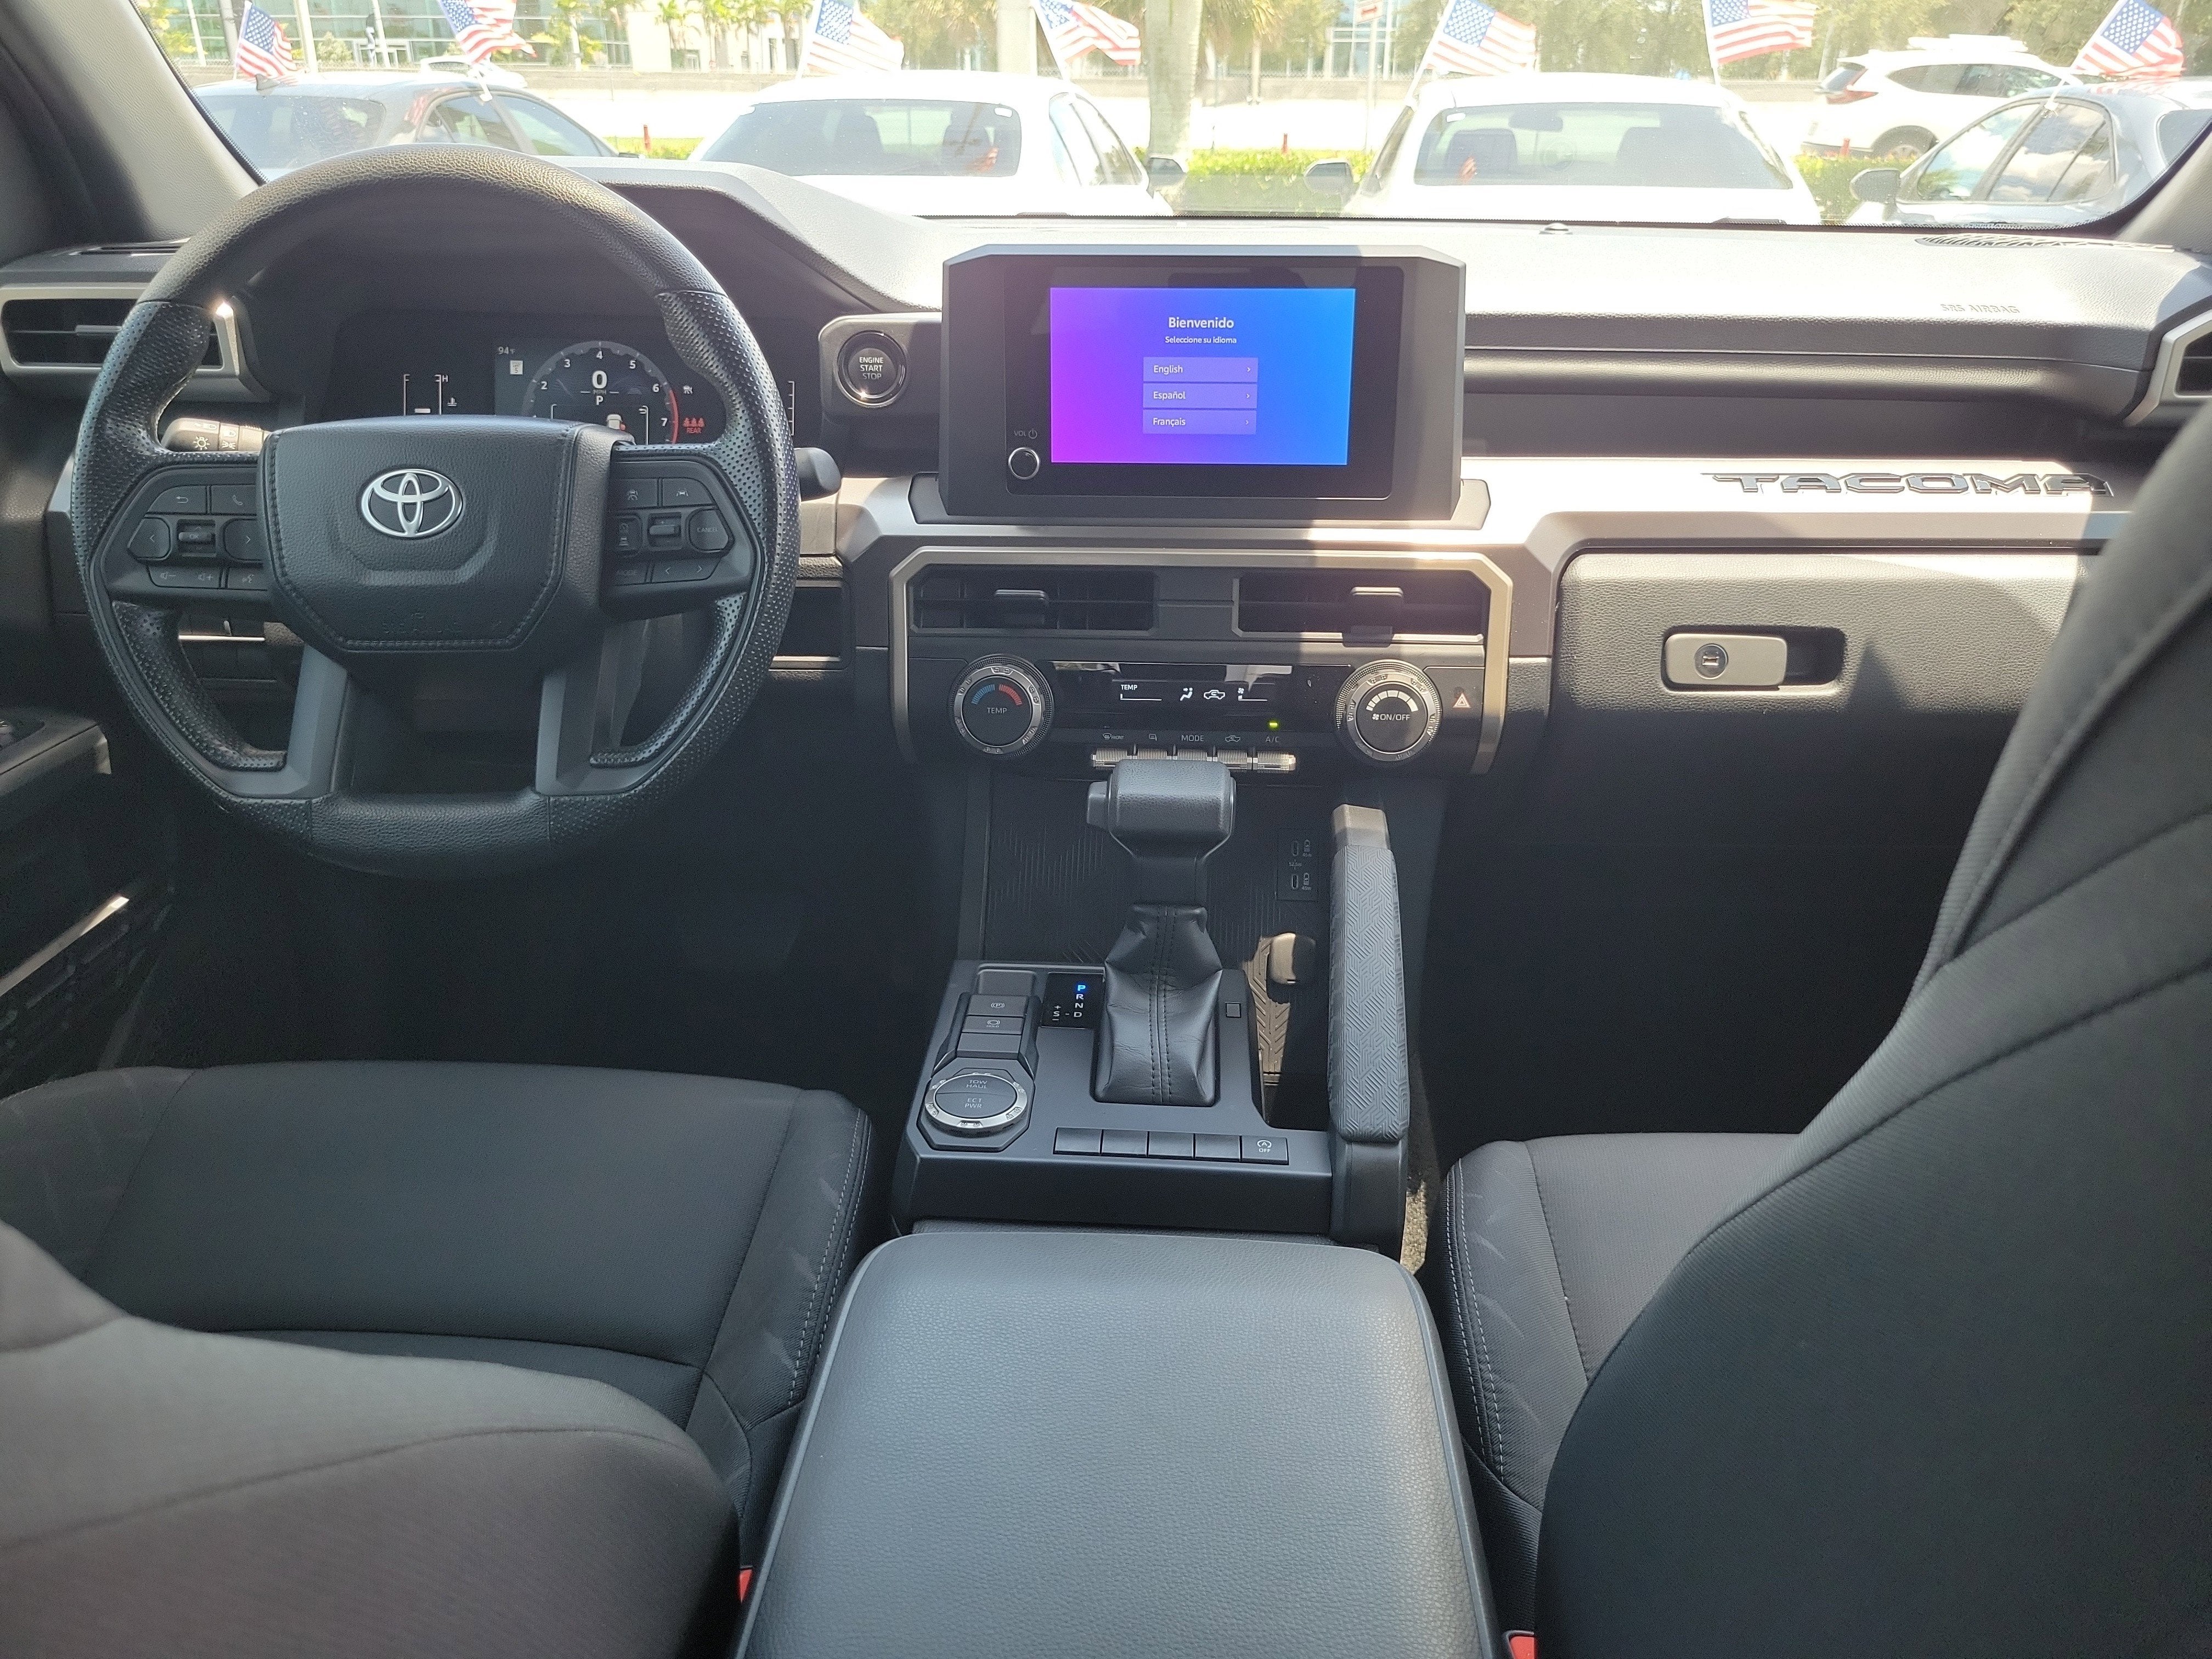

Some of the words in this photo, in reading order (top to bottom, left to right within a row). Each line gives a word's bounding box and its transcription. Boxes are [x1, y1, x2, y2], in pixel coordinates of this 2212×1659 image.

[1168, 317, 1234, 328] Bienvenido
[1165, 336, 1202, 344] Seleccione
[1212, 336, 1237, 344] idioma
[596, 351, 603, 360] 4
[564, 359, 571, 368] 3
[629, 360, 636, 369] 5
[1153, 365, 1183, 375] English
[592, 370, 608, 389] 0
[540, 381, 548, 390] 2
[652, 384, 659, 393] 6
[596, 396, 604, 405] P
[1153, 391, 1186, 401] Español
[661, 417, 668, 427] 7
[1153, 417, 1186, 427] Français
[1702, 472, 2113, 495] TACOMA
